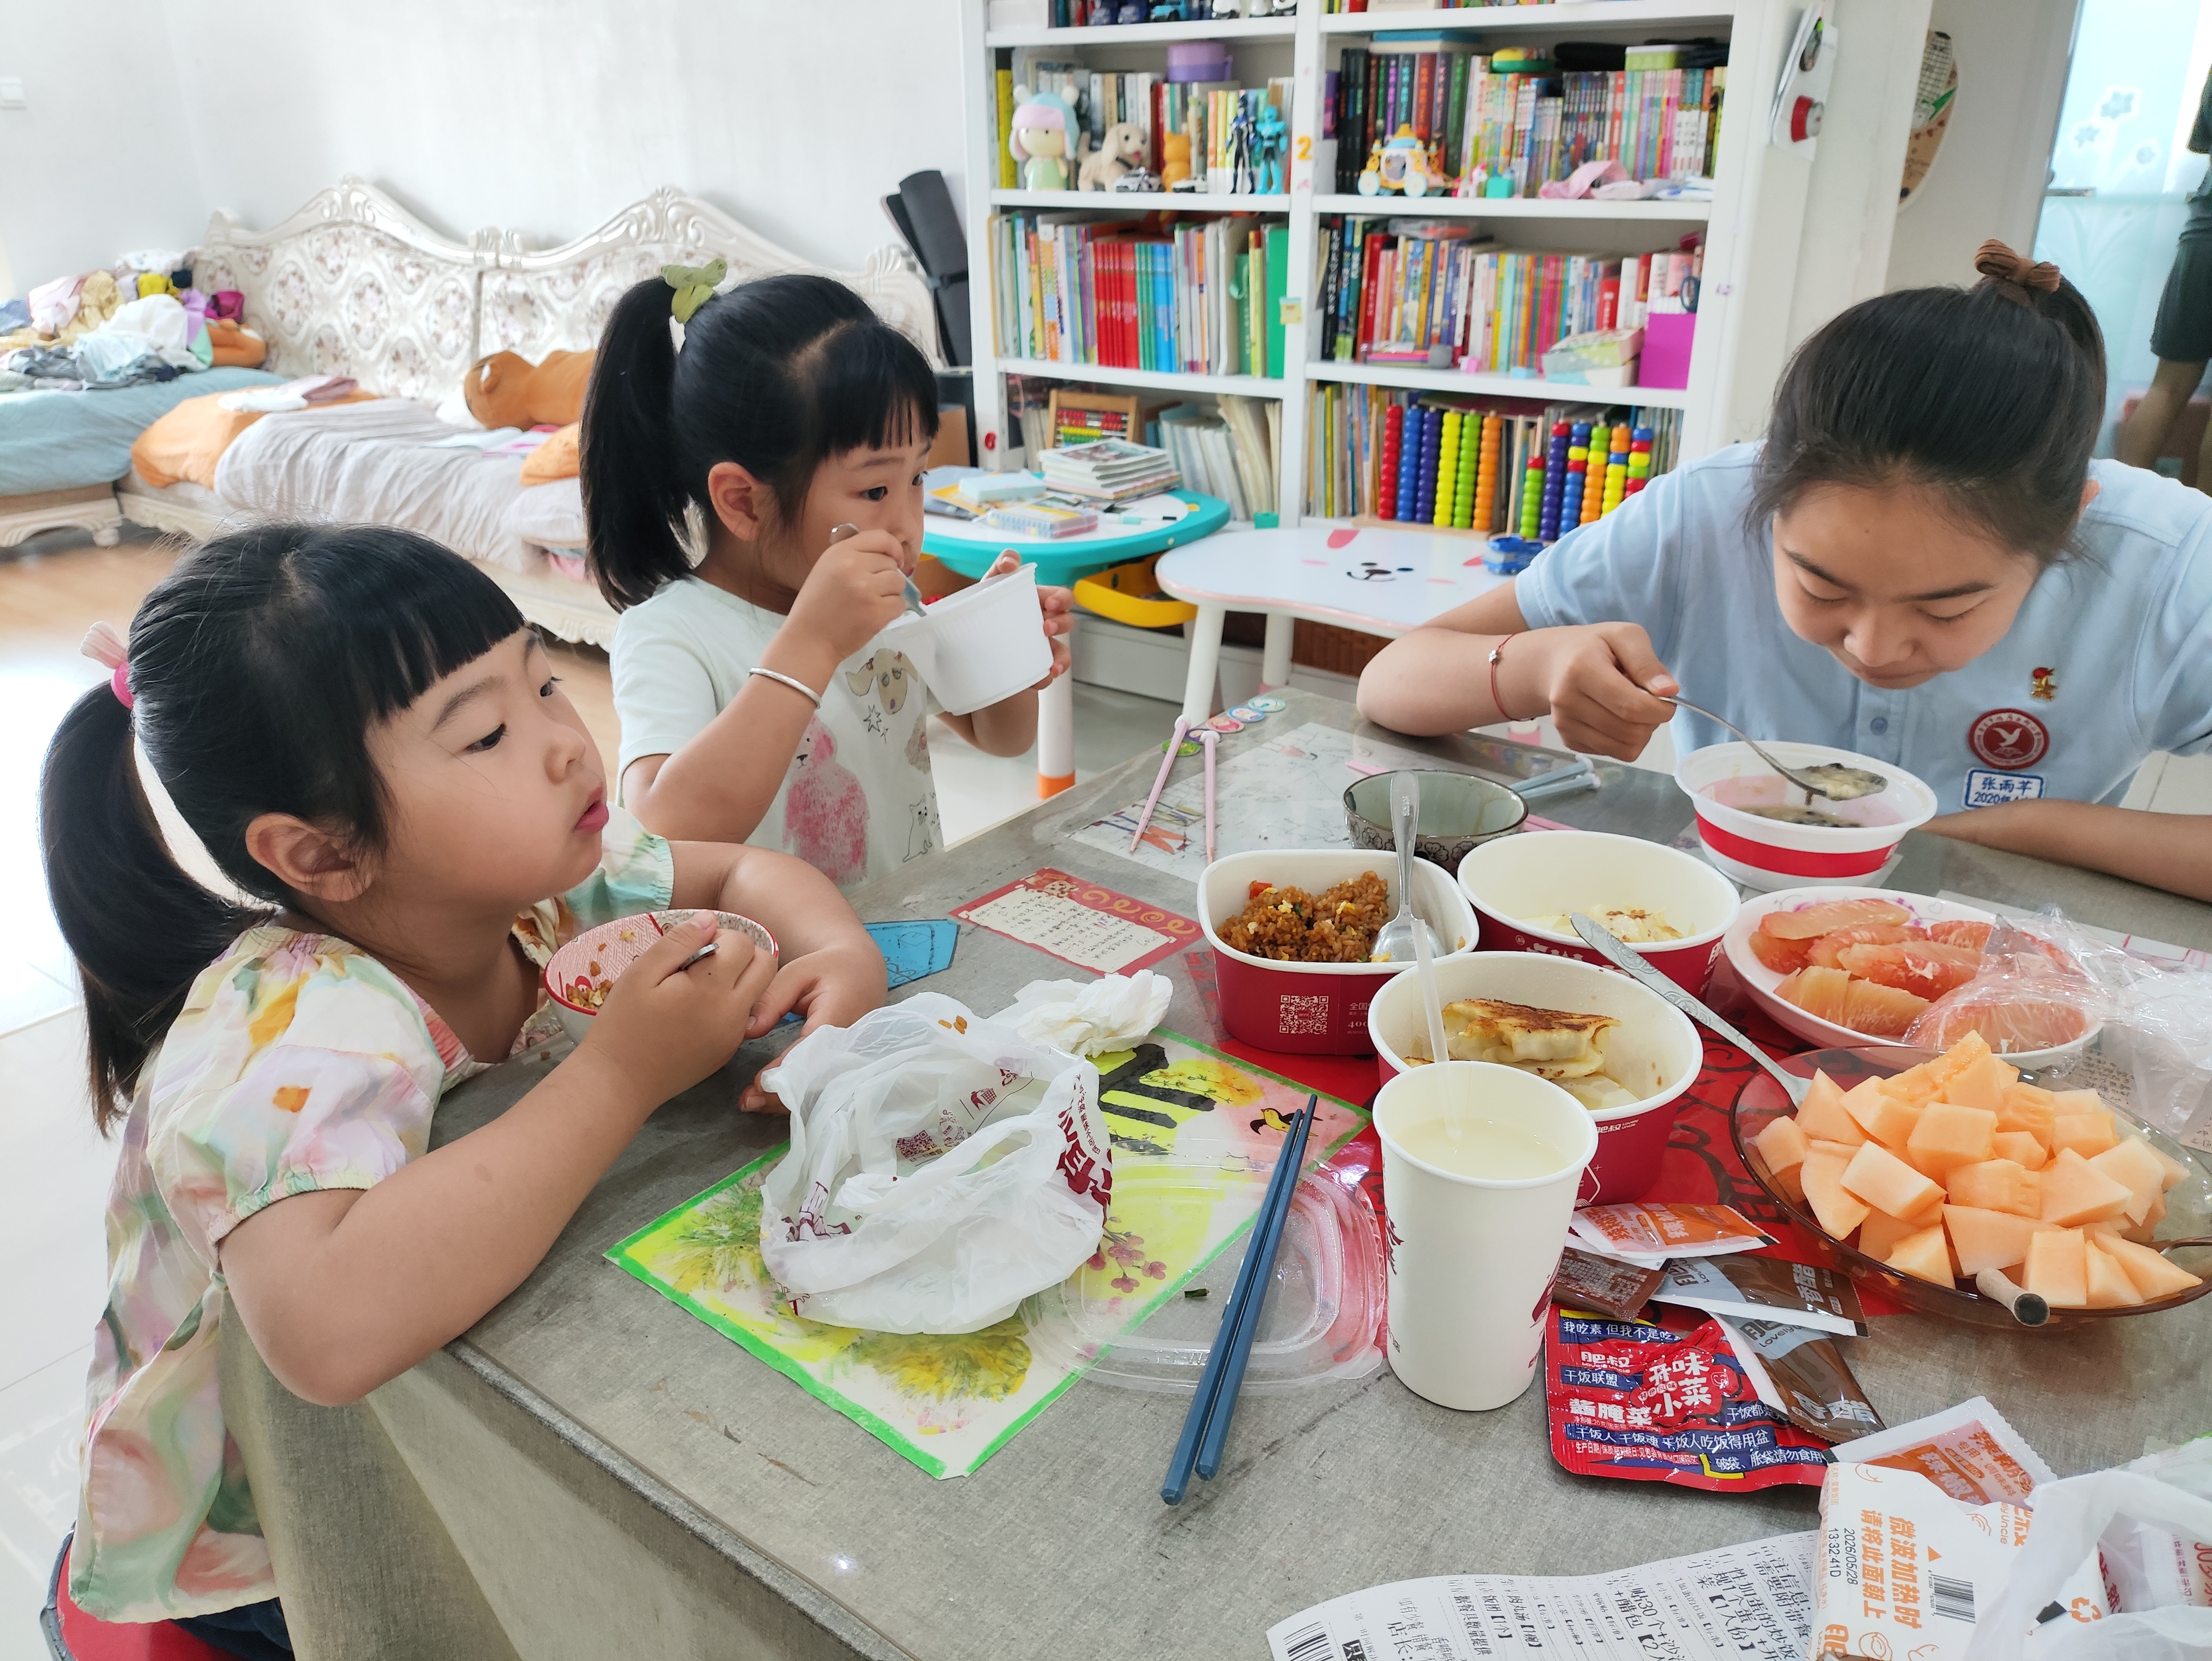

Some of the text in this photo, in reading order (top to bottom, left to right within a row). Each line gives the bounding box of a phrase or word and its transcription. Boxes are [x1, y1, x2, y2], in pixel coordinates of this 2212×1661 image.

[1349, 1002, 1371, 1011] 全国
[1563, 1320, 1602, 1335] 我吃素
[1581, 1351, 1630, 1368] 肥叔
[1564, 1369, 1619, 1387] 干饭联盟
[1569, 1398, 1653, 1427] 酱腌菜
[1576, 1427, 1771, 1451] 干饭人 干饭魂 干饭人吃饭得用盆
[1828, 1528, 1842, 1578] 13:32:41D
[1843, 1528, 1858, 1585] 2026/05/28
[1861, 1509, 1887, 1619] 请将此面朝上
[1889, 1516, 1922, 1629] 微波加热时
[1746, 1549, 1812, 1646] 不需要附带餐
